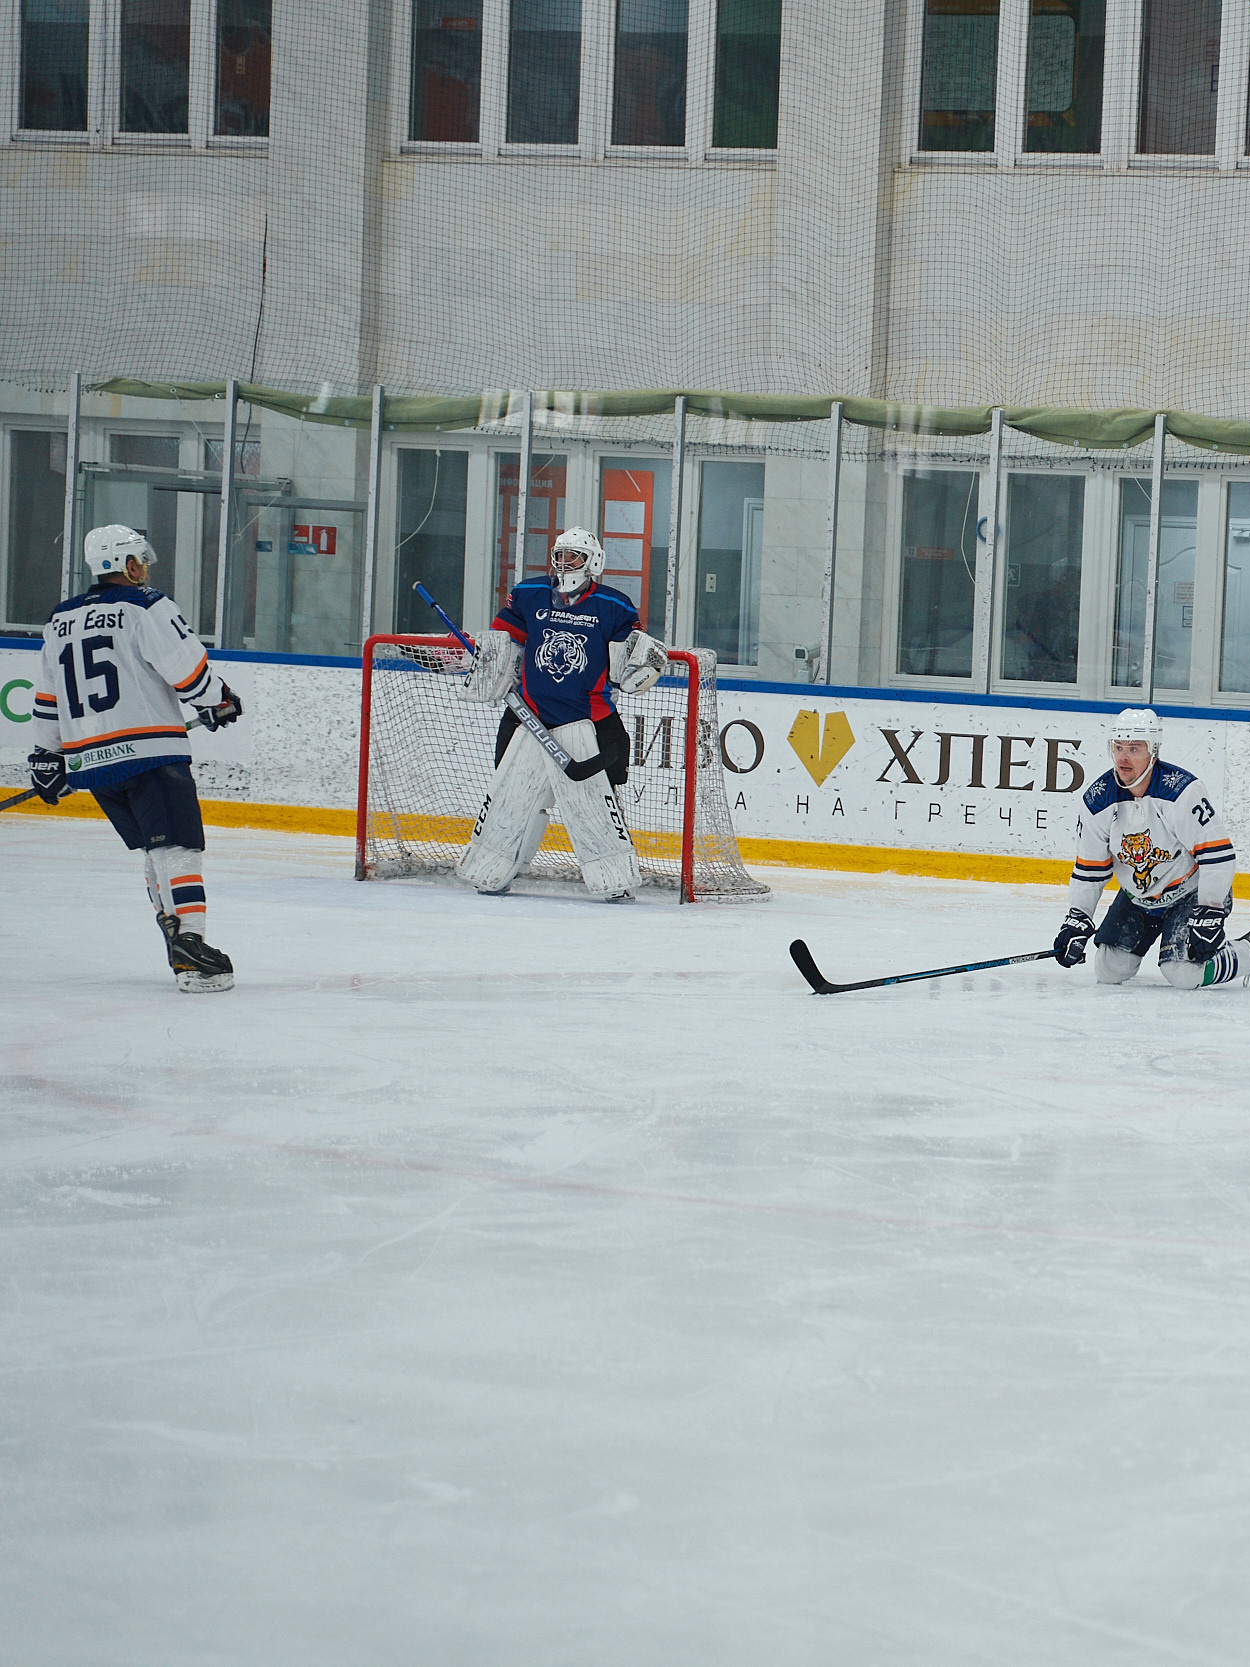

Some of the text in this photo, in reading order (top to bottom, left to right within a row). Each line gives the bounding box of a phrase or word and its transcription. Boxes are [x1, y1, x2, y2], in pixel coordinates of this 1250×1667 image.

[84, 609, 125, 631] East
[58, 634, 120, 719] 15
[516, 706, 569, 766] BAUER
[630, 714, 1085, 793] ИВО ХЛЕБ
[30, 761, 60, 771] UER
[474, 793, 492, 837] CCM
[604, 794, 628, 841] CCM
[796, 794, 845, 817] НА
[894, 800, 1048, 830] ГРЕЧЕ
[1191, 797, 1216, 827] 23
[1186, 917, 1223, 928] AUER
[1010, 955, 1036, 965] NEXUS
